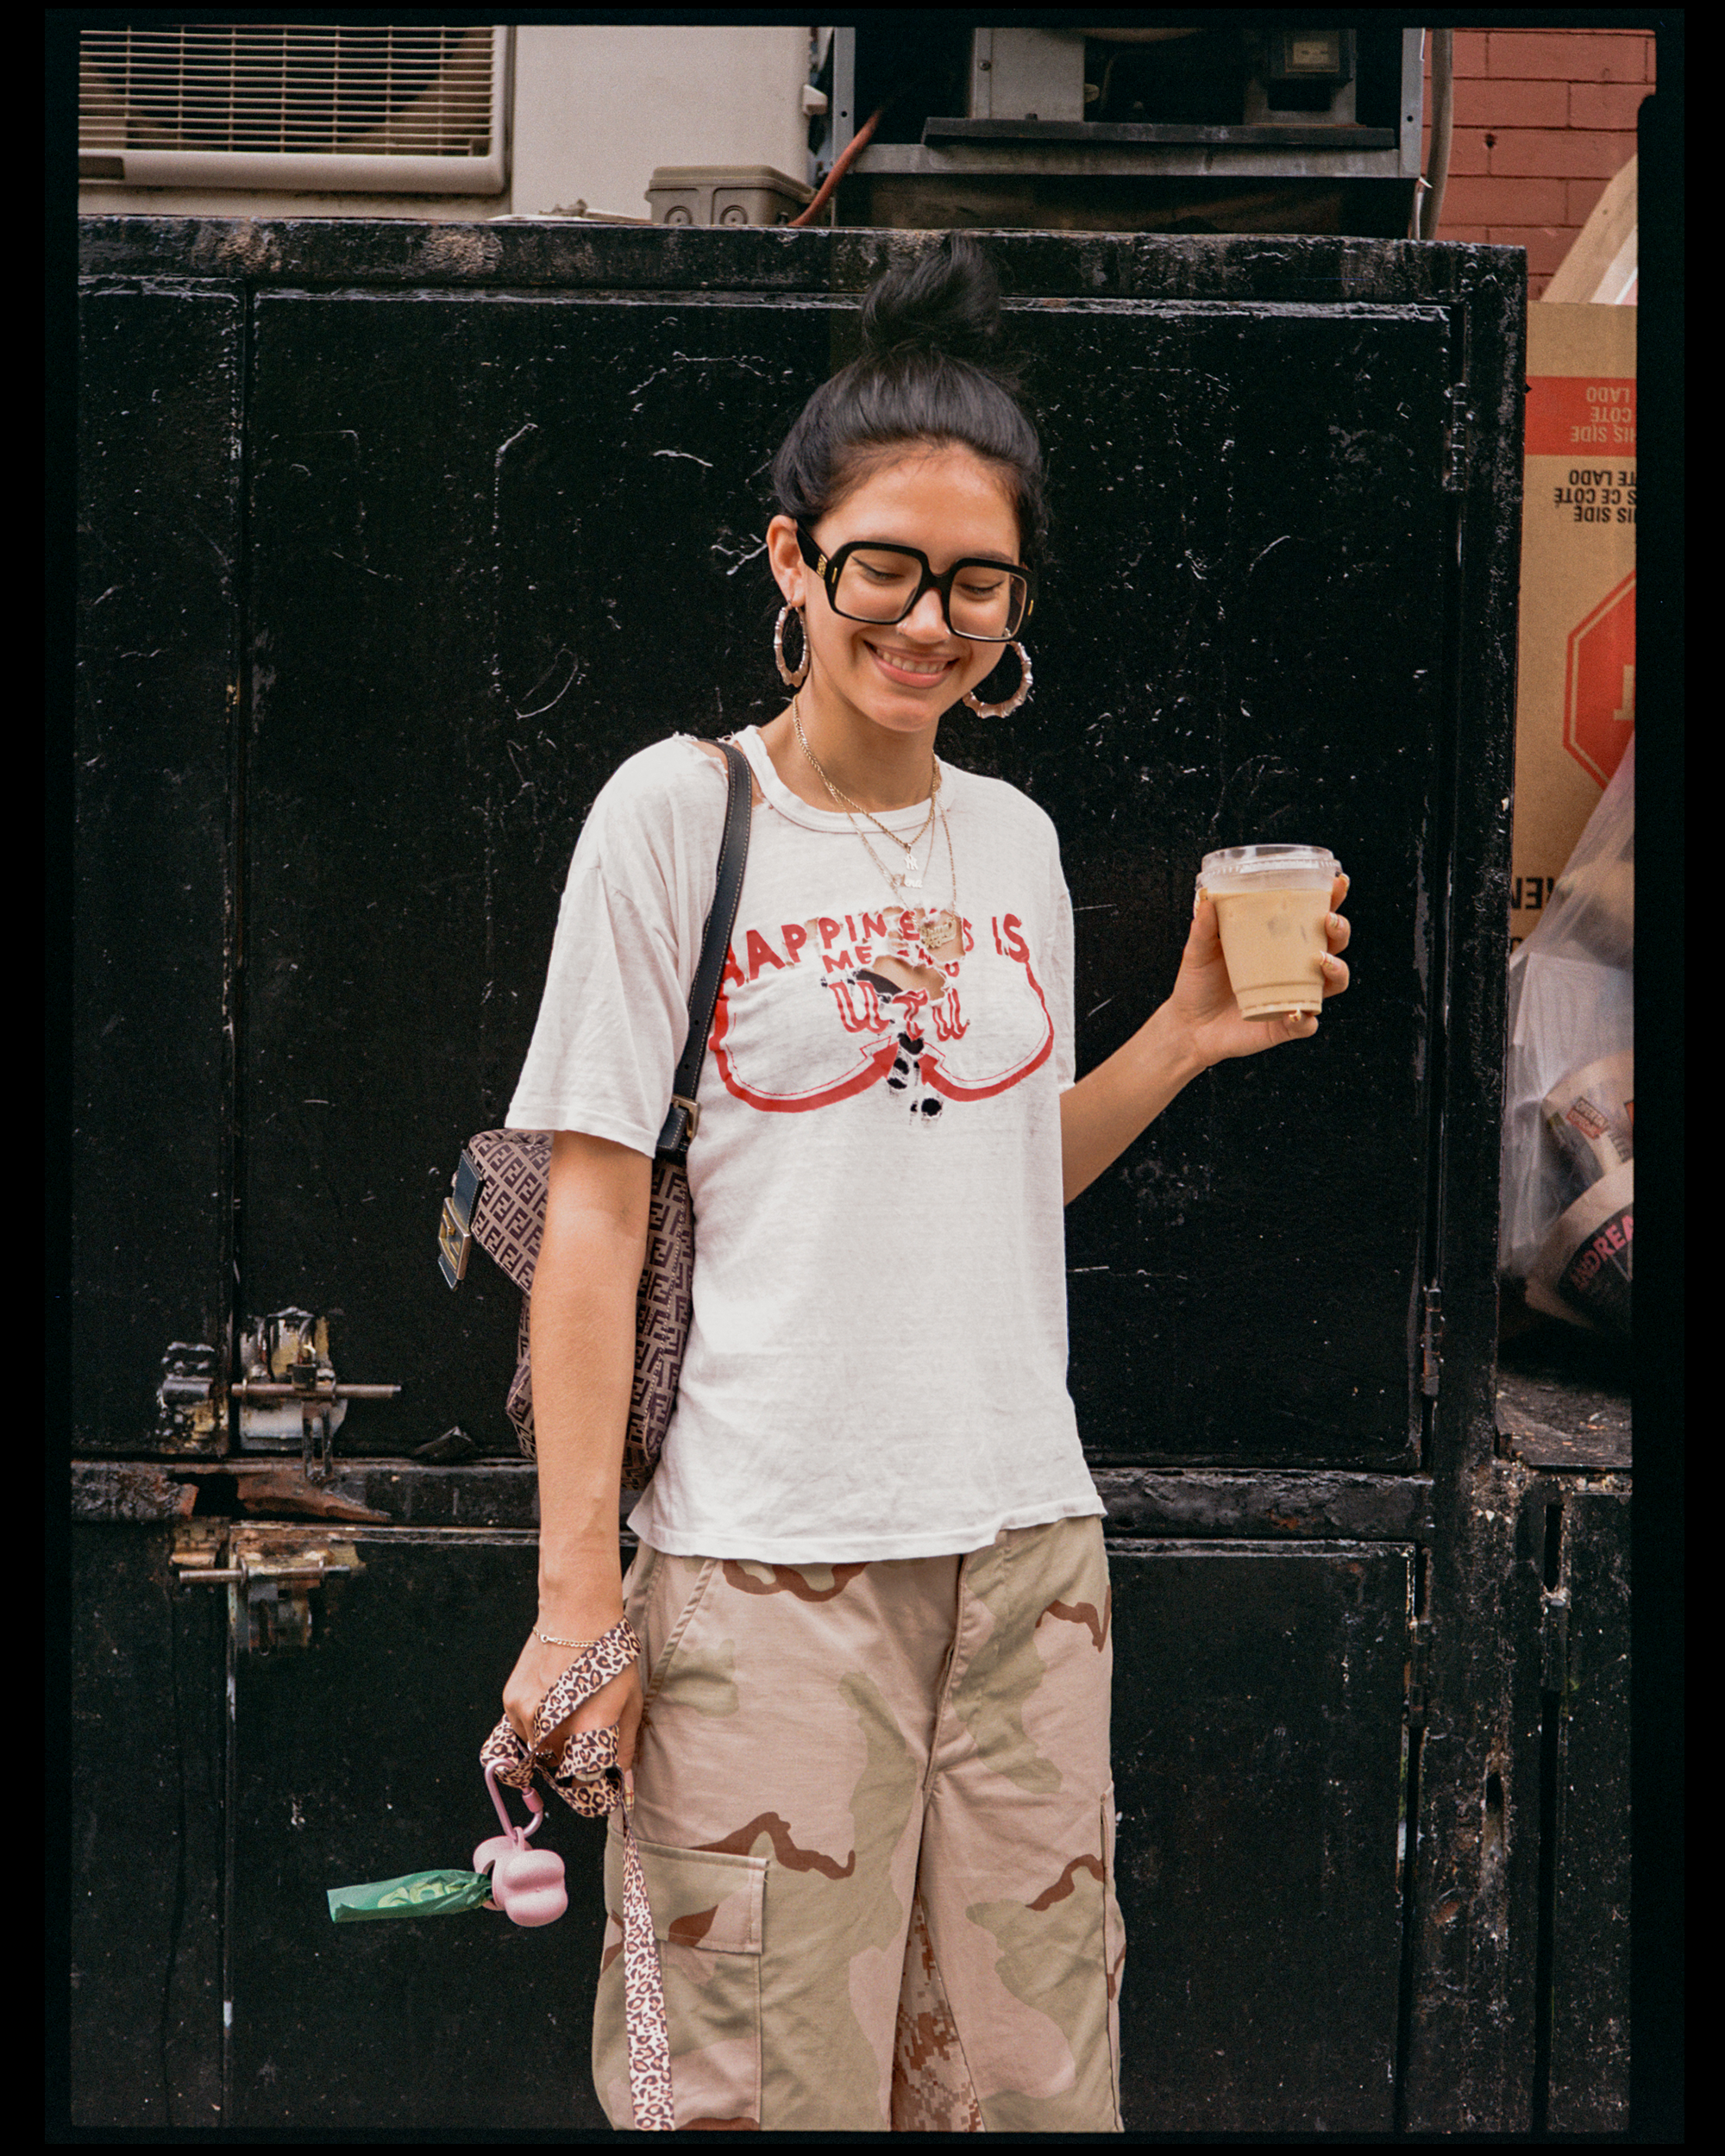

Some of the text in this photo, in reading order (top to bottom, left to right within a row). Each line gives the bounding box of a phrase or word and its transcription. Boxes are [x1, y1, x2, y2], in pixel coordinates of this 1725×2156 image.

[1586, 386, 1629, 403] LADO
[1571, 425, 1608, 443] SIDE
[1569, 469, 1612, 486] LADO
[1602, 488, 1622, 505] CE
[1574, 505, 1611, 523] SIDE
[991, 912, 1031, 963] IS
